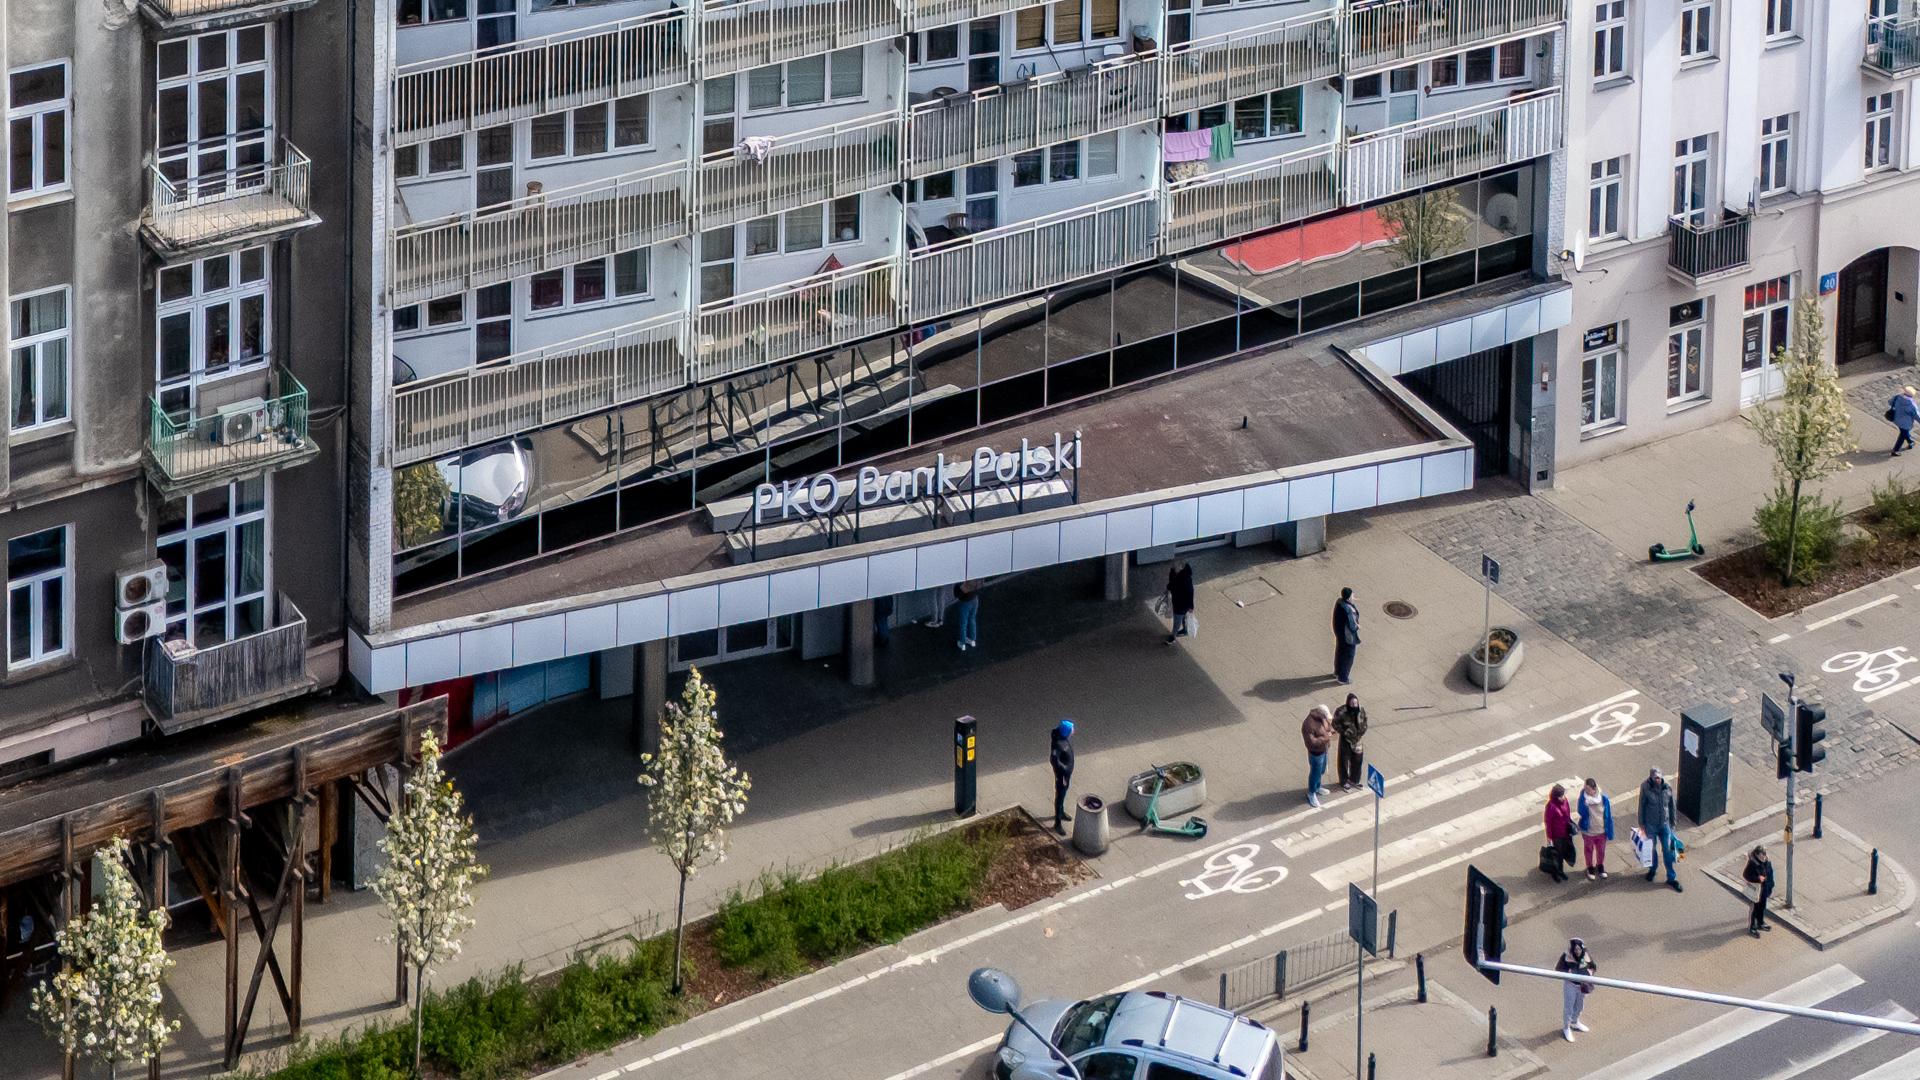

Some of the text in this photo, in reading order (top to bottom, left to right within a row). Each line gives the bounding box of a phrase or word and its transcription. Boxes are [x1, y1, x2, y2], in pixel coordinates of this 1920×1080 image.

[1824, 278, 1836, 289] 40
[755, 430, 1082, 524] PKO Bank Polski
